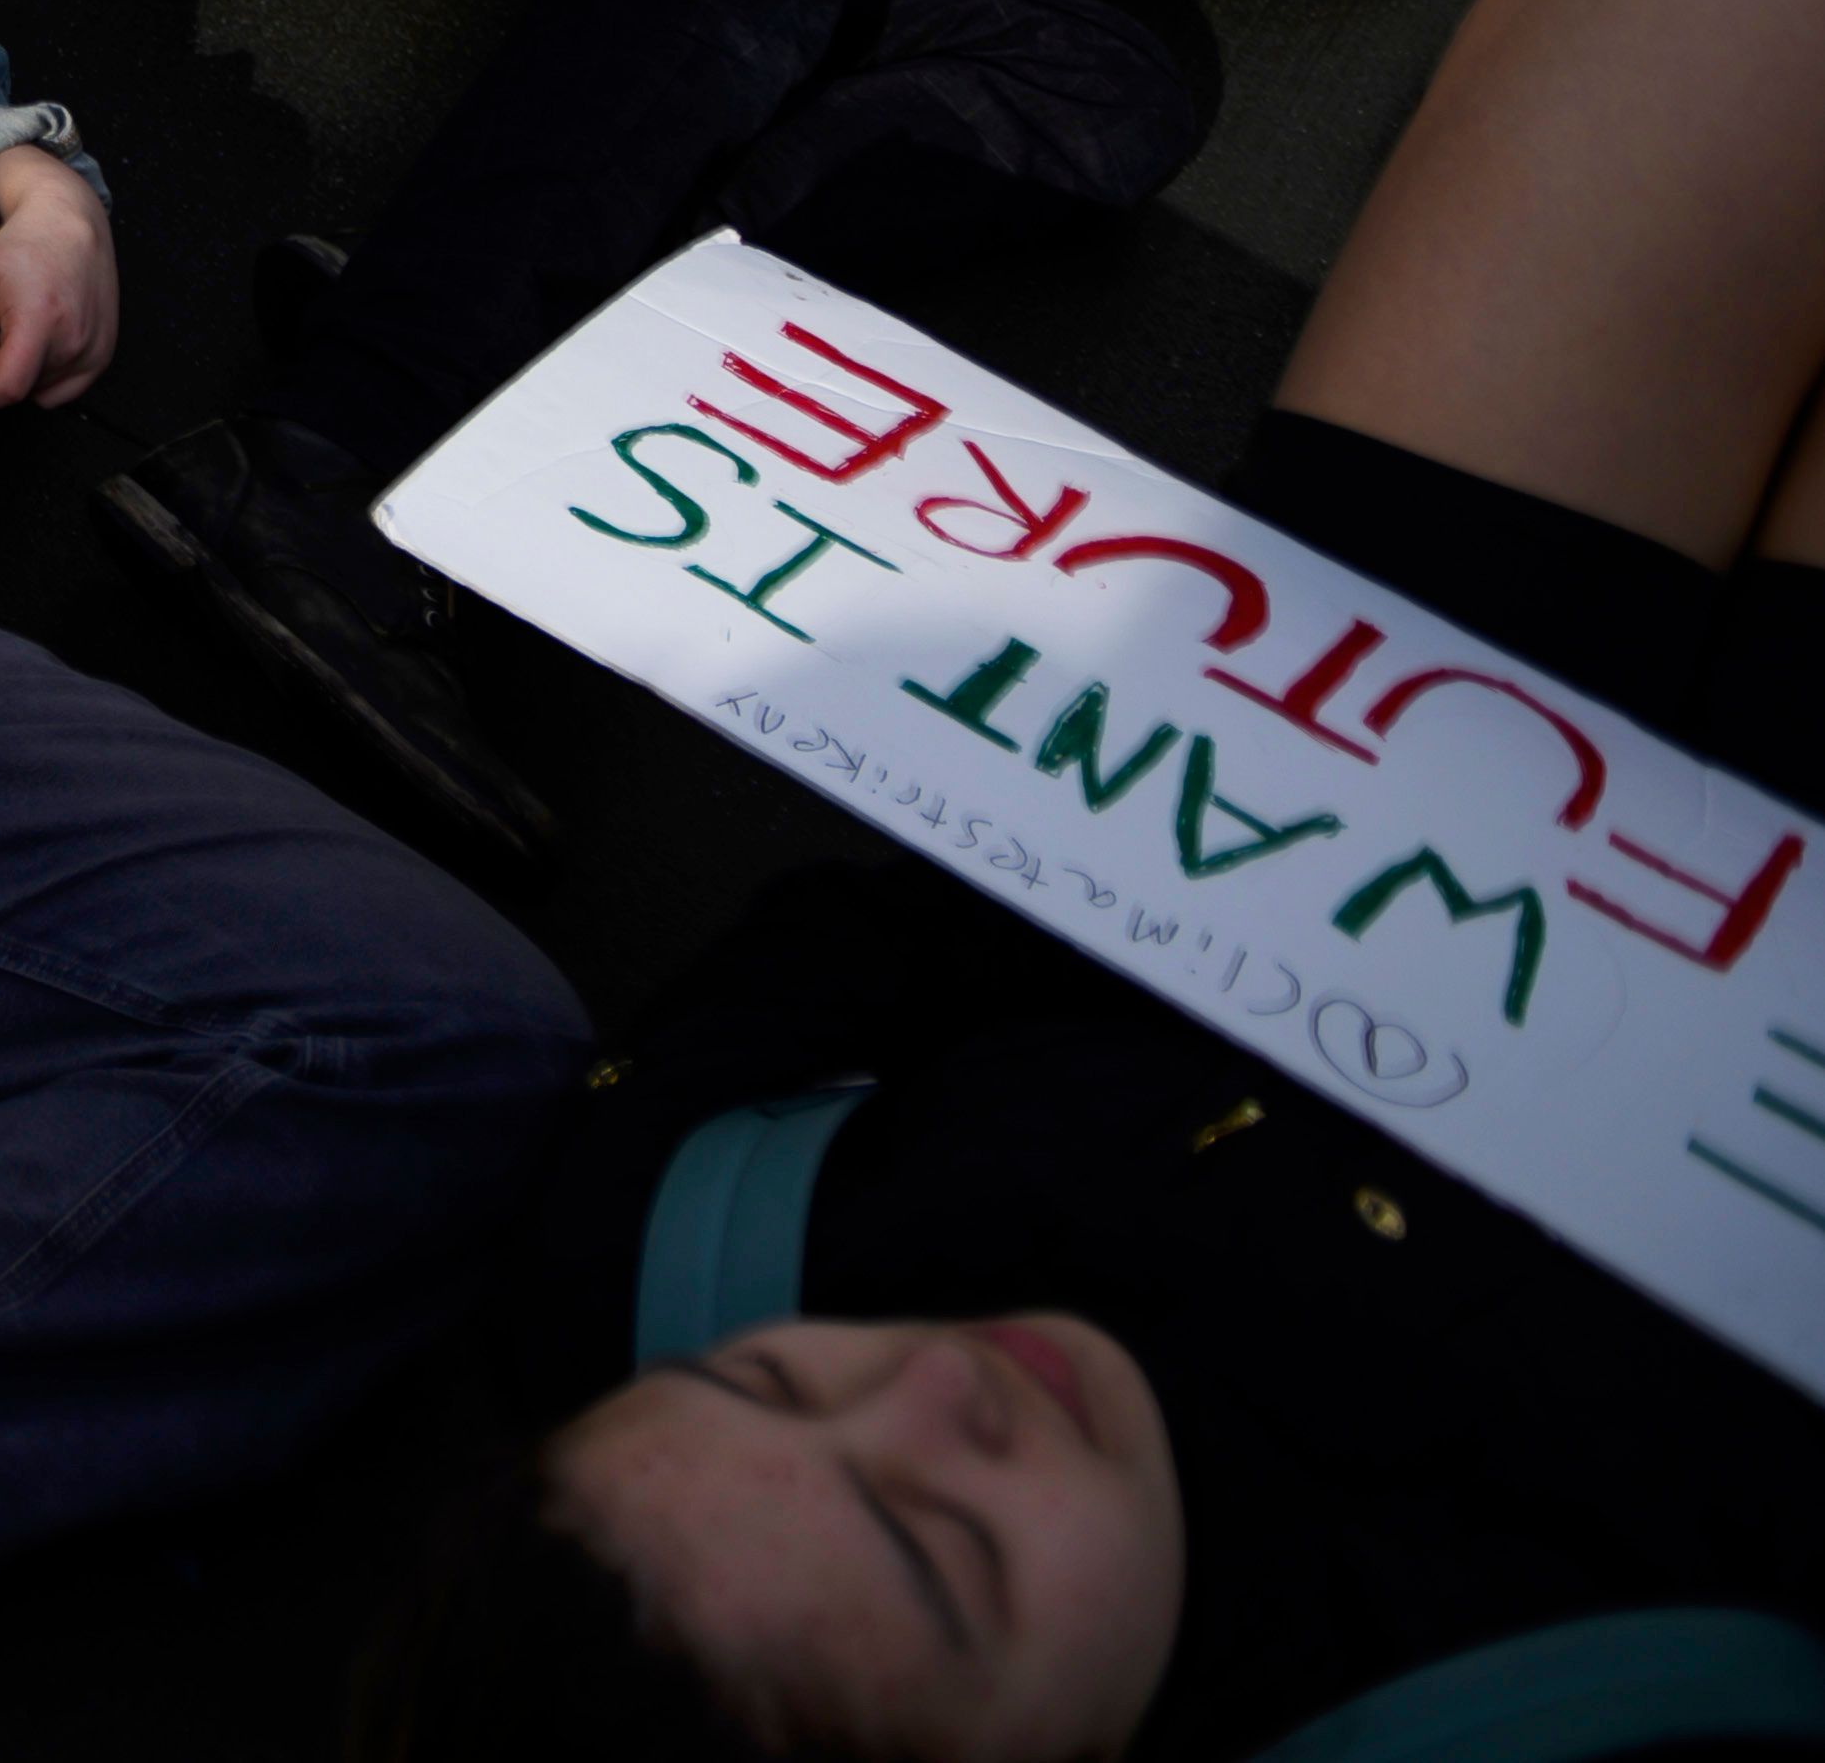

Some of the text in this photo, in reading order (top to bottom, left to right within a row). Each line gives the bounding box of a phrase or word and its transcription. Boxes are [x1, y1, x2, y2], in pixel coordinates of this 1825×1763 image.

[567, 423, 903, 643] IS
[687, 320, 1804, 971] FUTURE
[901, 638, 1545, 1027] WANT
